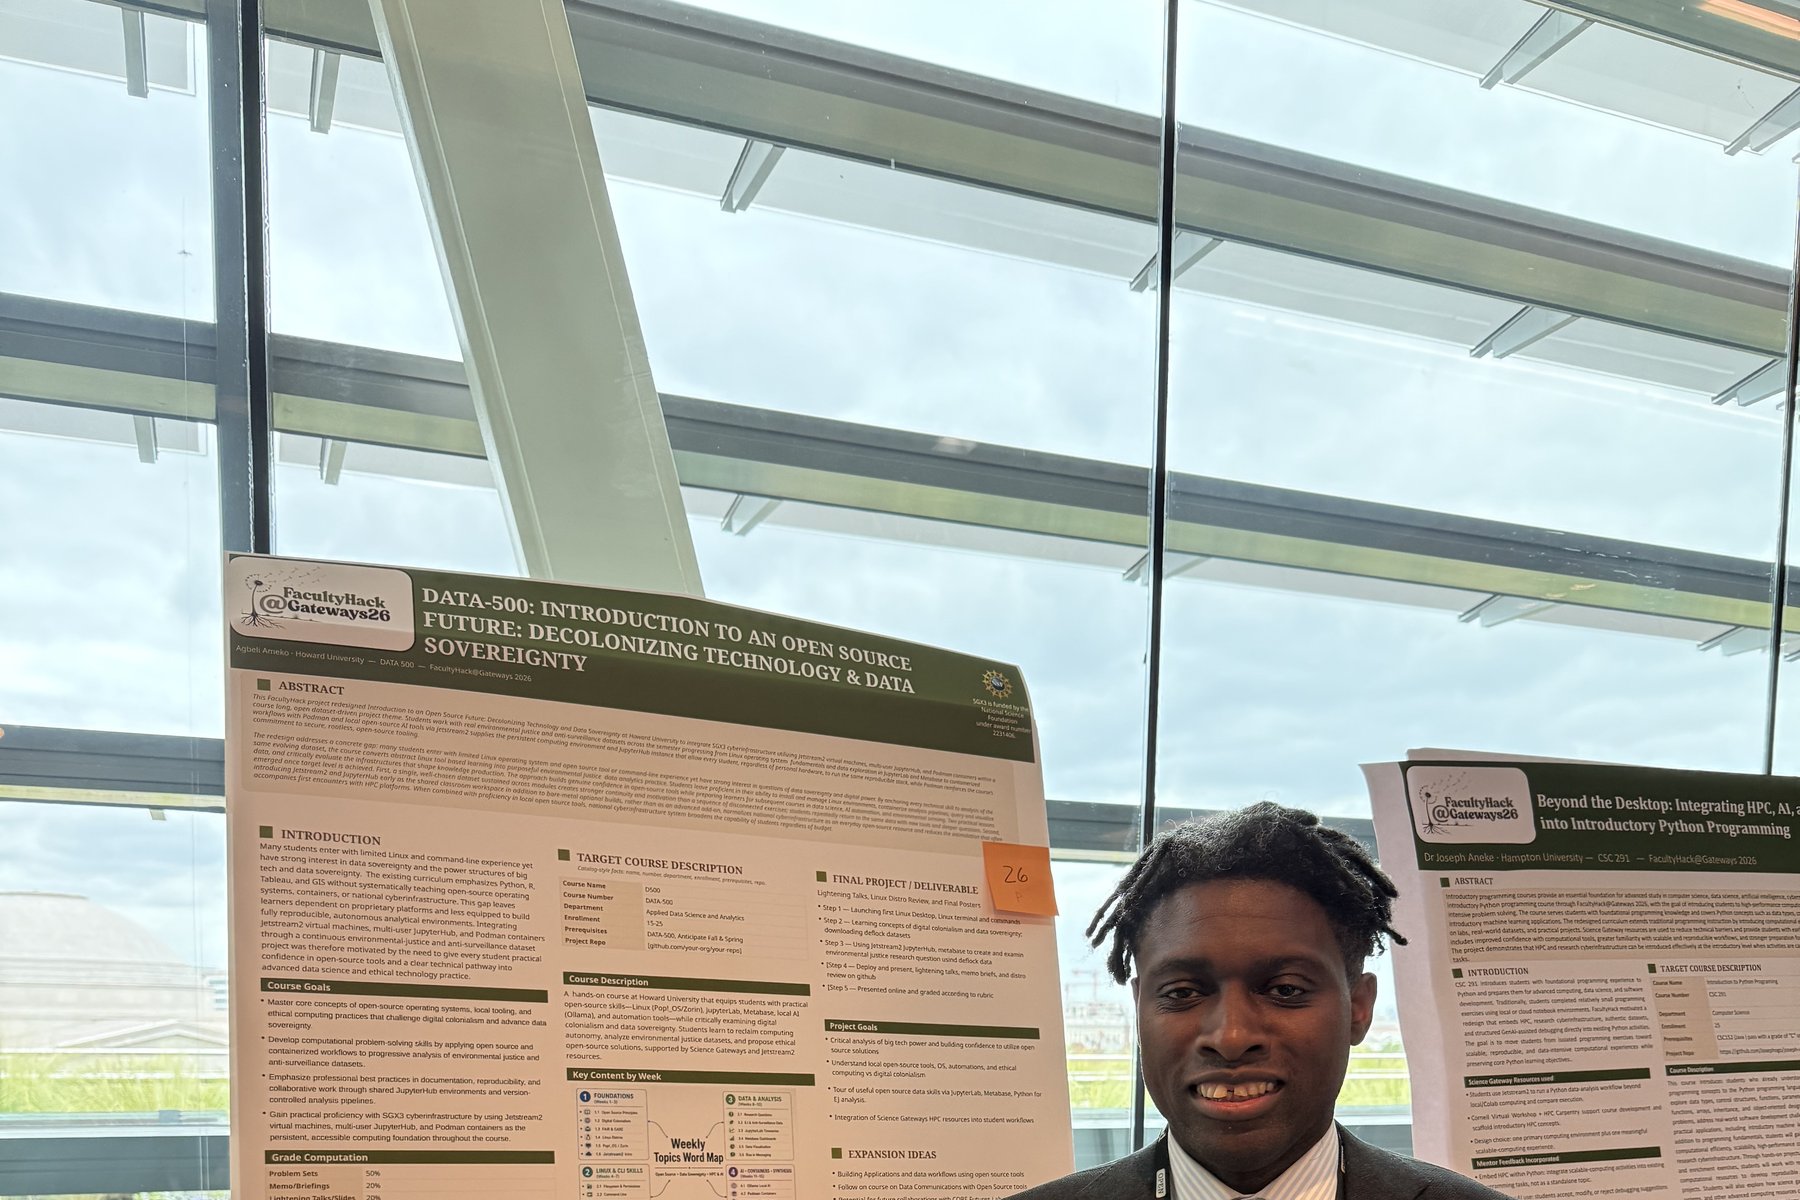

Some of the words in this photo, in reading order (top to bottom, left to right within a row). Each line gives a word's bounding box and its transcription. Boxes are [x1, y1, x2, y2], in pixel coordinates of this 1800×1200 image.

[283, 586, 386, 608] FacultyHack
[260, 594, 390, 622] @Gateways26
[422, 587, 534, 614] DATA-500:
[540, 600, 710, 637] INTRODUCTION
[714, 623, 742, 642] TO
[747, 629, 776, 648] AN
[782, 635, 833, 657] OPEN
[838, 645, 912, 671] SOURCE
[423, 611, 522, 637] FUTURE:
[528, 623, 698, 660] DECOLONIZING
[702, 646, 841, 682] TECHNOLOGY
[846, 669, 861, 685] &
[864, 671, 915, 694] DATA
[424, 636, 587, 671] SOVEREIGNTY
[235, 644, 260, 653] Agbeli
[262, 647, 289, 656] Ameko
[295, 650, 325, 659] Howard
[326, 653, 364, 664] University
[379, 658, 399, 666] DATA
[514, 673, 532, 682] 2026
[278, 681, 344, 695] ABSTRACT
[1444, 797, 1513, 810] FacultyHack
[1536, 793, 1588, 811] Beyond
[1590, 794, 1612, 808] the
[1614, 796, 1672, 814] Desktop:
[1674, 798, 1745, 817] Integrating
[1746, 800, 1775, 816] HPC,
[1777, 802, 1794, 816] AI,
[1432, 805, 1518, 822] @Gateways26
[1540, 816, 1568, 829] into
[1570, 816, 1656, 835] Introductory
[1658, 819, 1705, 835] Python
[1706, 820, 1791, 839] Programming
[281, 829, 380, 845] INTRODUCTION
[576, 852, 622, 864] TARGET
[624, 856, 668, 869] COURSE
[670, 860, 742, 874] DESCRIPTION
[1423, 852, 1434, 861] Dr
[1436, 852, 1466, 863] Joseph
[1467, 852, 1494, 862] Aneke
[1500, 853, 1541, 863] Hampton
[1542, 852, 1583, 863] University
[1597, 853, 1614, 862] CSC
[1614, 853, 1630, 862] 291
[1738, 855, 1757, 865] 2026
[1002, 865, 1028, 883] 26
[832, 874, 863, 885] FINAL
[865, 877, 906, 889] PROJECT
[908, 880, 912, 890] /
[913, 881, 978, 894] DELIVERABLE
[1467, 967, 1528, 976] INTRODUCTION
[267, 981, 301, 992] Course
[303, 982, 330, 991] Goals
[569, 974, 599, 985] Course
[600, 976, 649, 988] Description
[829, 1022, 856, 1032] Project
[858, 1023, 878, 1032] Goals
[573, 1071, 588, 1081] Key
[590, 1071, 624, 1080] Content
[626, 1072, 636, 1082] by
[638, 1072, 662, 1081] Week
[670, 1138, 706, 1152] Weekly
[272, 1153, 302, 1162] Grade
[304, 1154, 368, 1163] Computation
[653, 1151, 681, 1164] Topics
[682, 1152, 704, 1162] Word
[706, 1152, 724, 1164] Map
[848, 1150, 905, 1158] EXPANSION
[907, 1150, 936, 1159] IDEAS
[269, 1182, 330, 1190] Memo/Briefings
